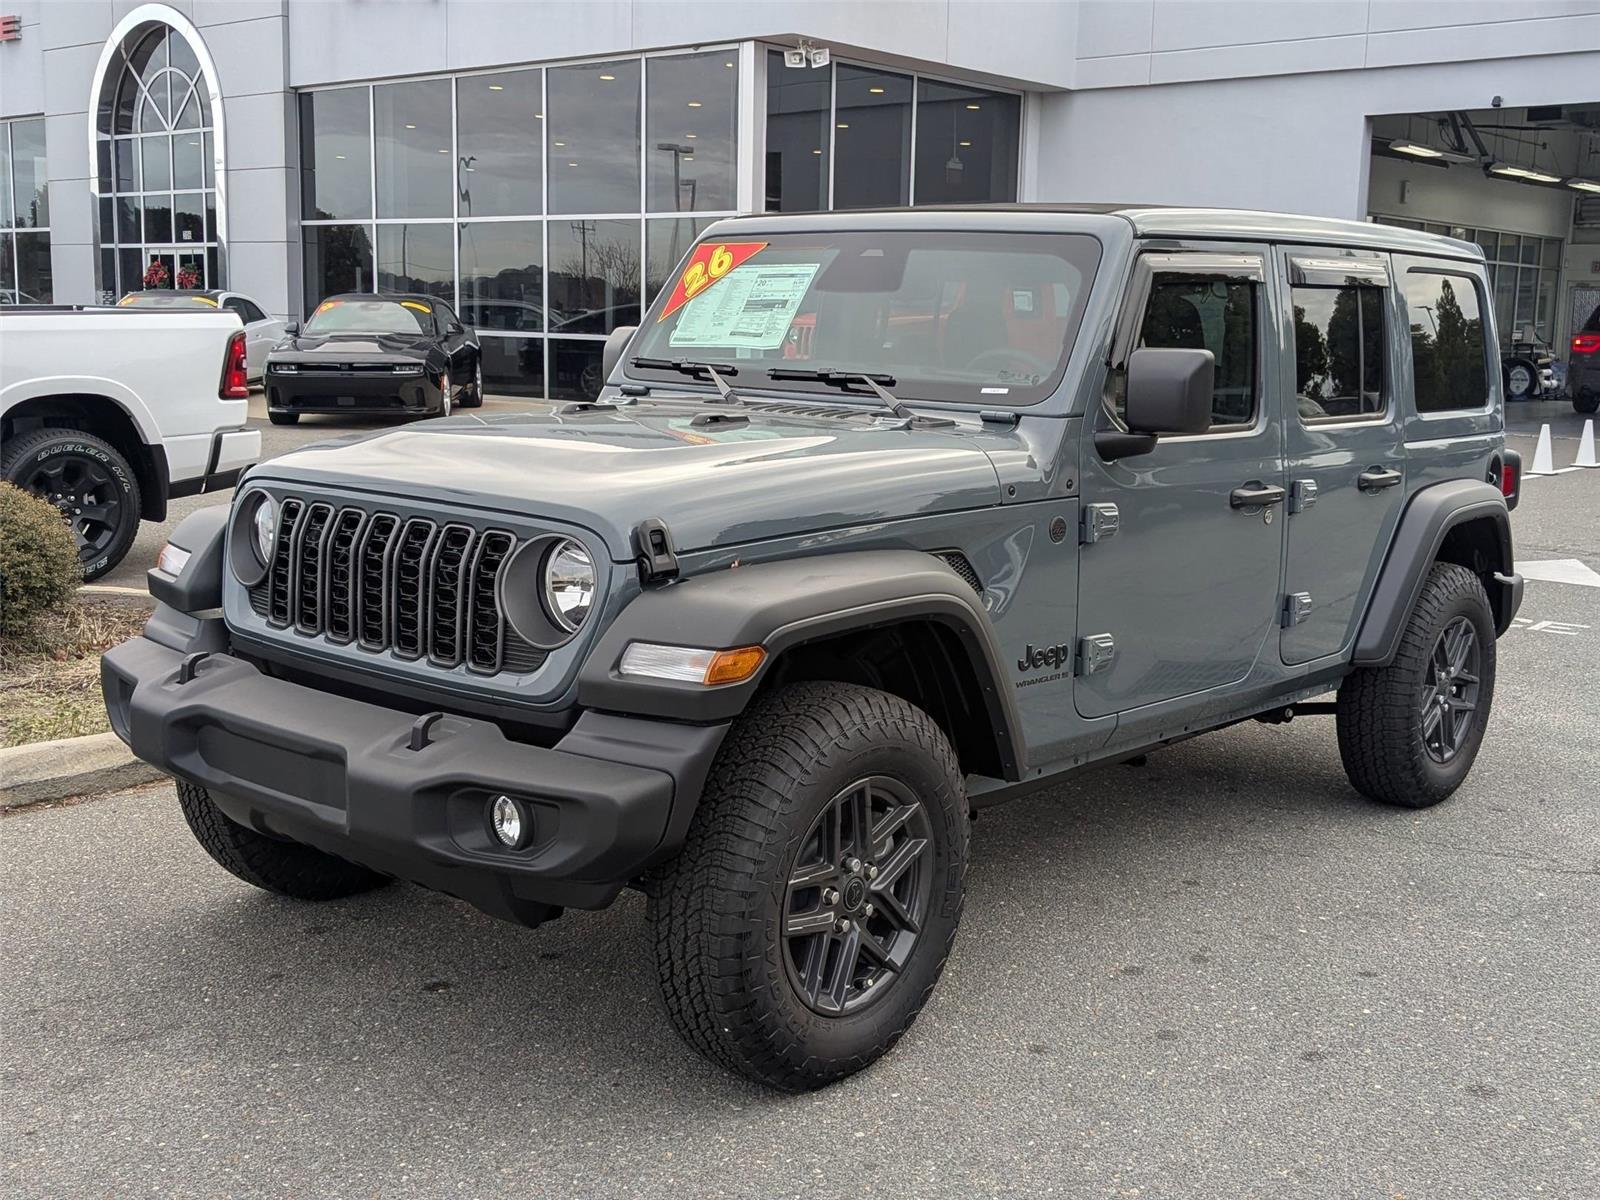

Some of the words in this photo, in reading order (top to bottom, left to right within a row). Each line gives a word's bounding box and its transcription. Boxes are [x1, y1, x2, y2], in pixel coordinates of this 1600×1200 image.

[683, 245, 733, 298] 26
[37, 444, 110, 462] DUELER
[1017, 643, 1069, 671] Jeep
[1015, 673, 1061, 688] WRANGLER
